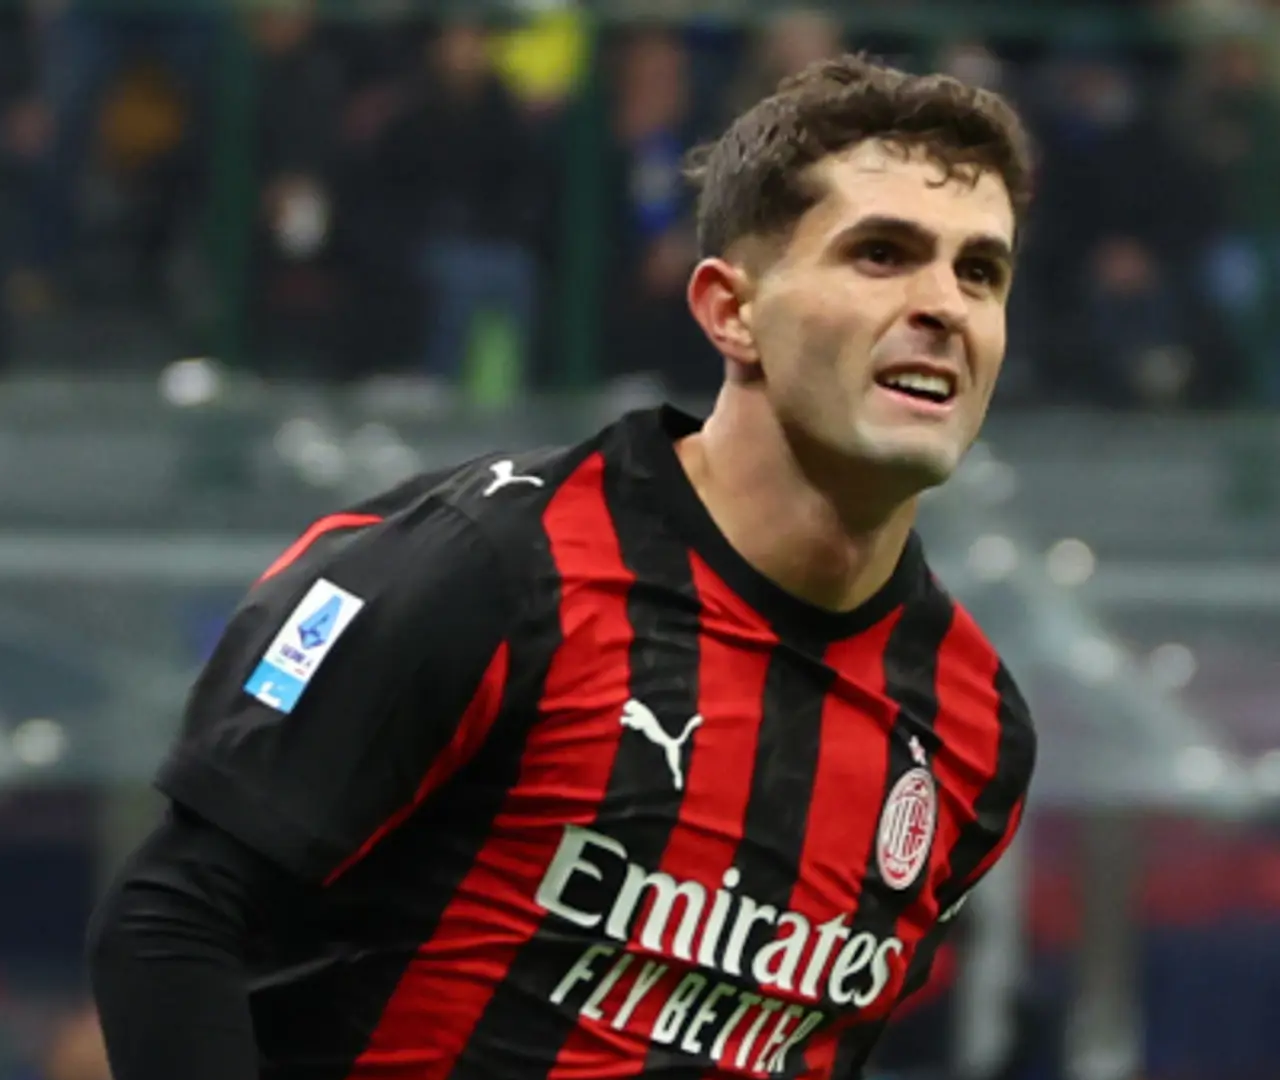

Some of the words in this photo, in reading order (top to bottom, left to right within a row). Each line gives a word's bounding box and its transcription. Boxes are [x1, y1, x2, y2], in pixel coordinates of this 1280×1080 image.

[535, 822, 903, 1008] Emirates
[548, 944, 669, 1031] FLY
[650, 972, 824, 1074] BETTER
